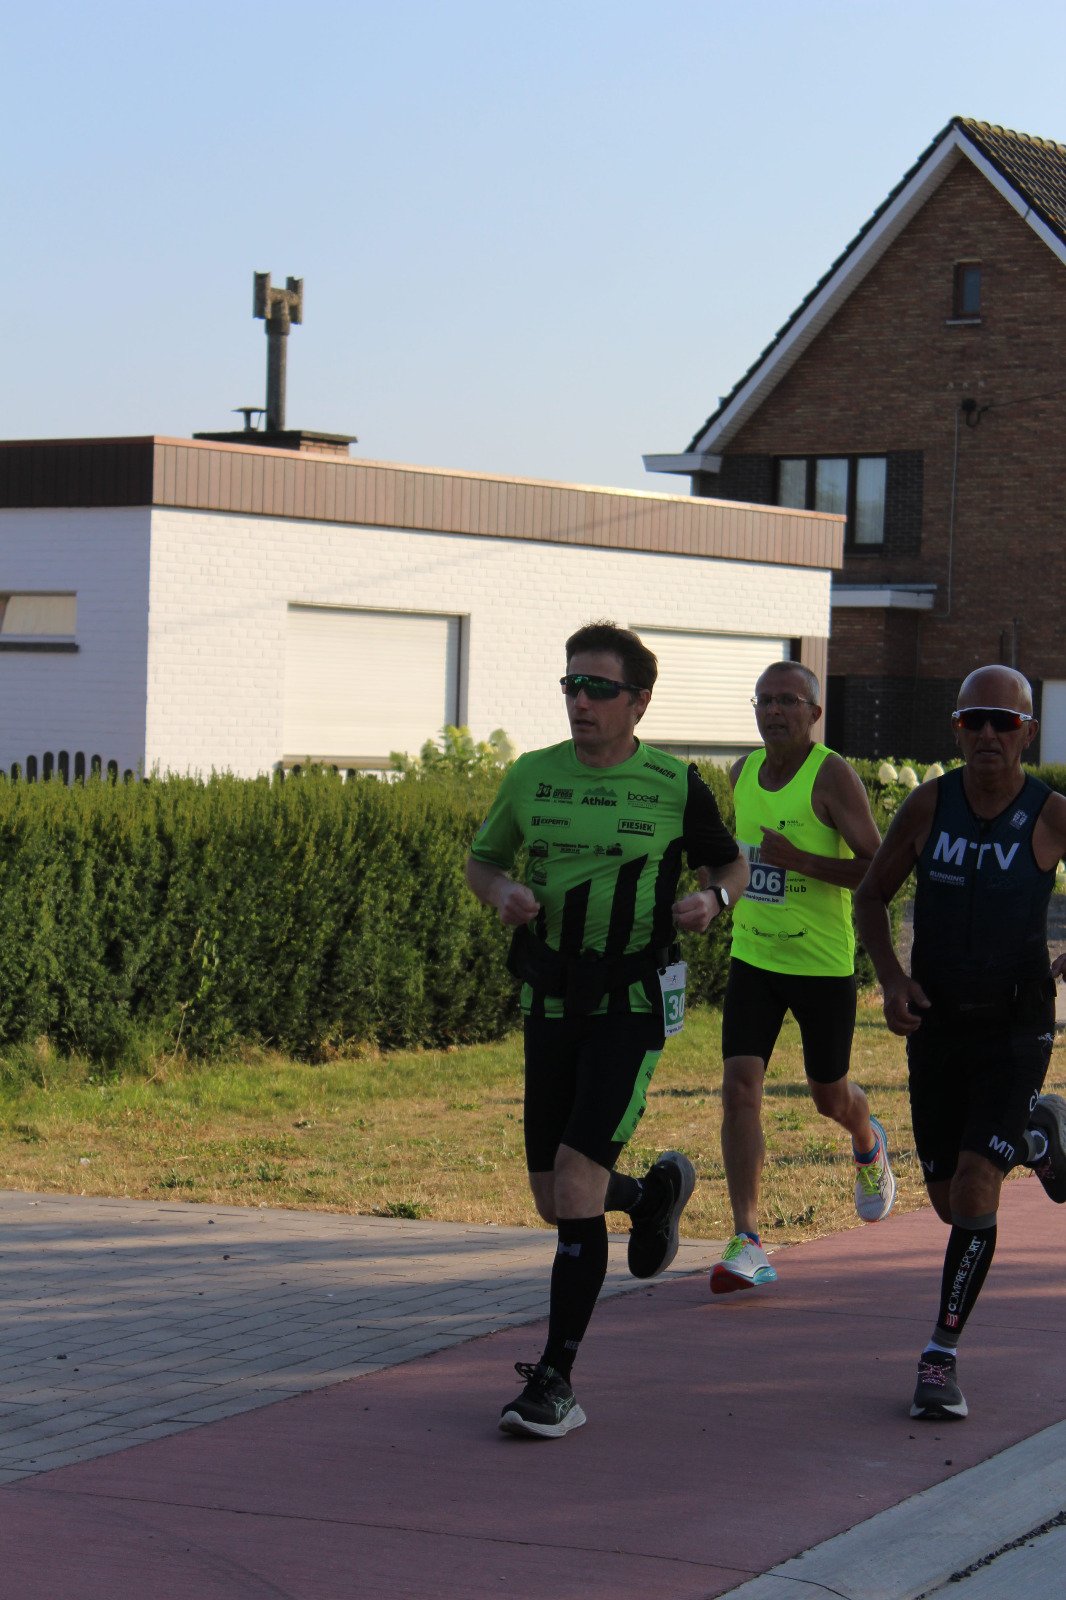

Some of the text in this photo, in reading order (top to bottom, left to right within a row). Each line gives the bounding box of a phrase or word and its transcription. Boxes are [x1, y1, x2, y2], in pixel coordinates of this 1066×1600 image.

[643, 762, 676, 780] BIORACER
[932, 831, 1020, 870] MTV
[751, 868, 781, 893] 06
[929, 870, 966, 883] RUNNING
